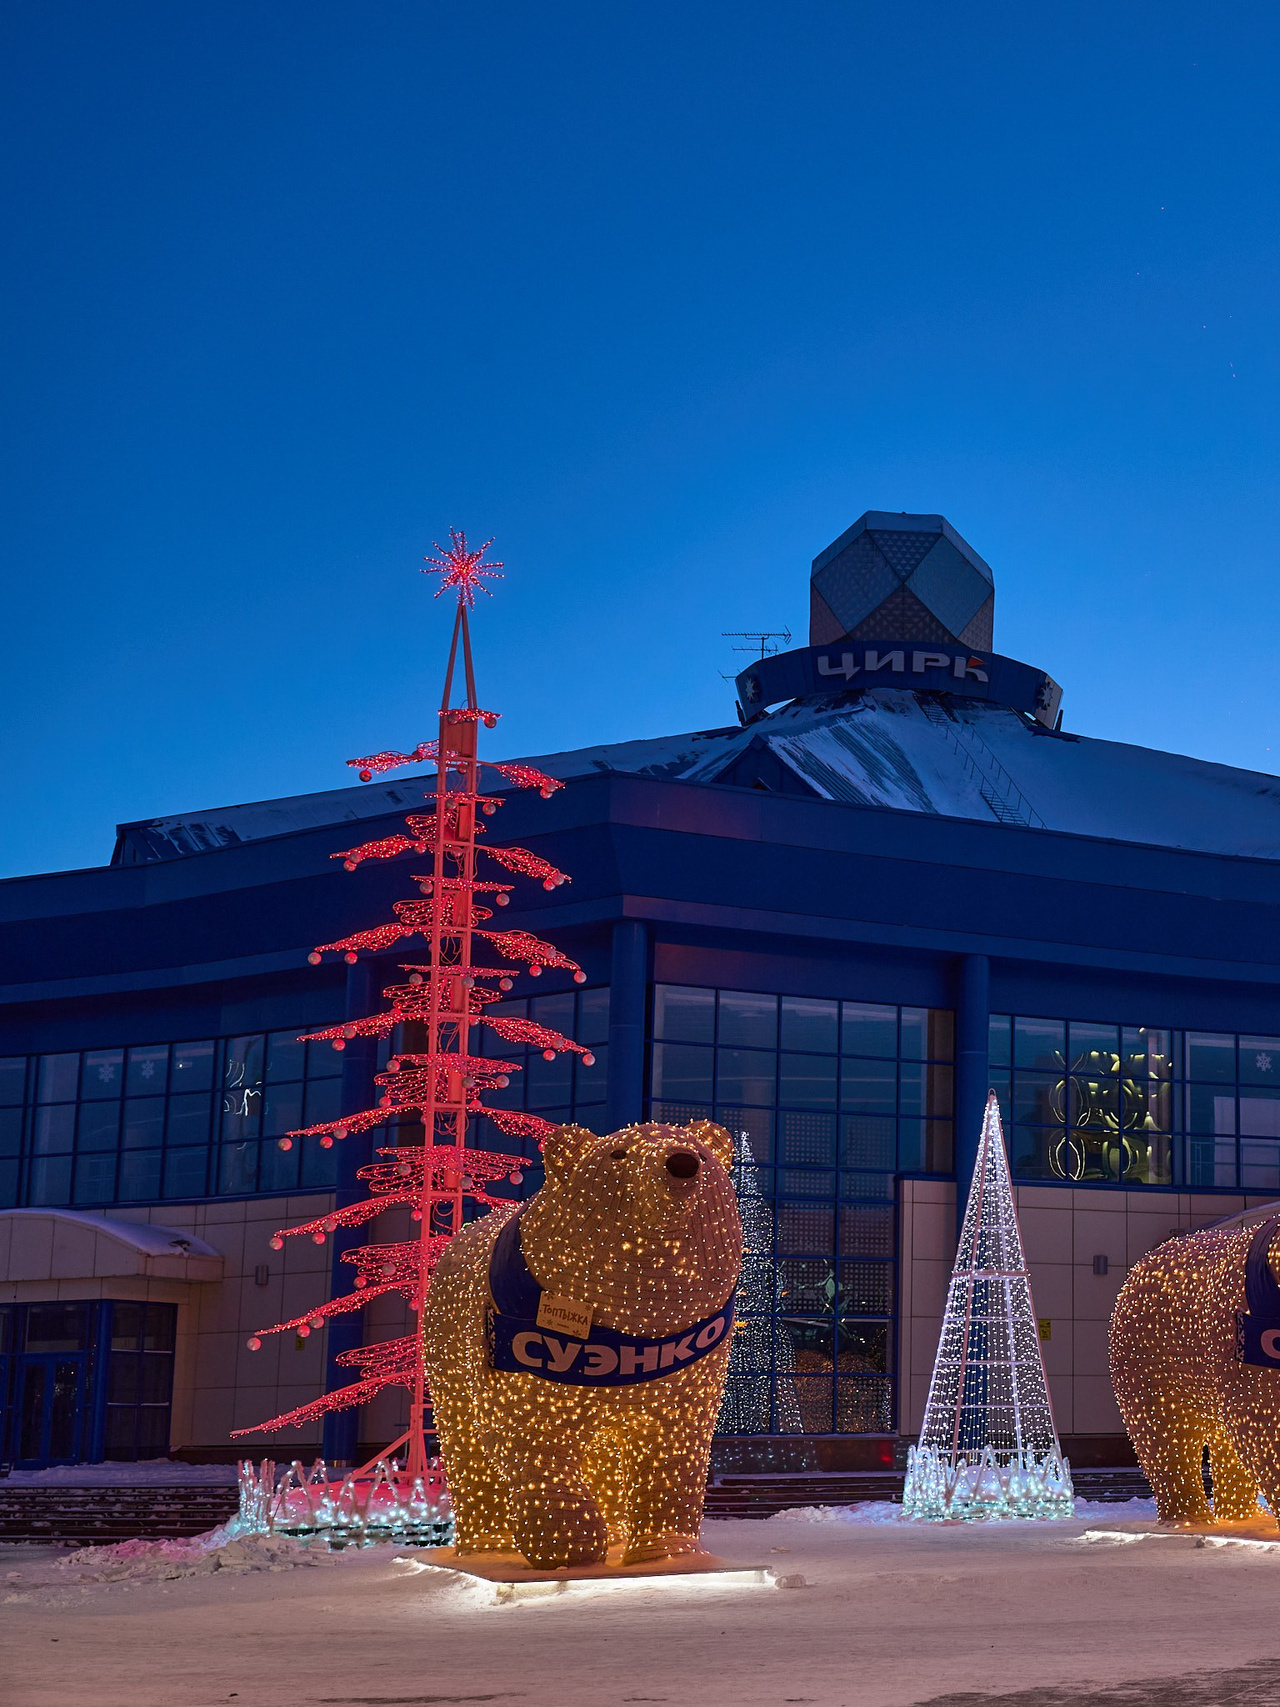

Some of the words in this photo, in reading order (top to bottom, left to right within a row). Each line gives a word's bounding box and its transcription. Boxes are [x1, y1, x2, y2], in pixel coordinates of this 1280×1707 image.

[817, 650, 989, 682] ЦИРК
[542, 1303, 588, 1326] ТОПТЫЖКА
[512, 1316, 726, 1376] СУЭНКО
